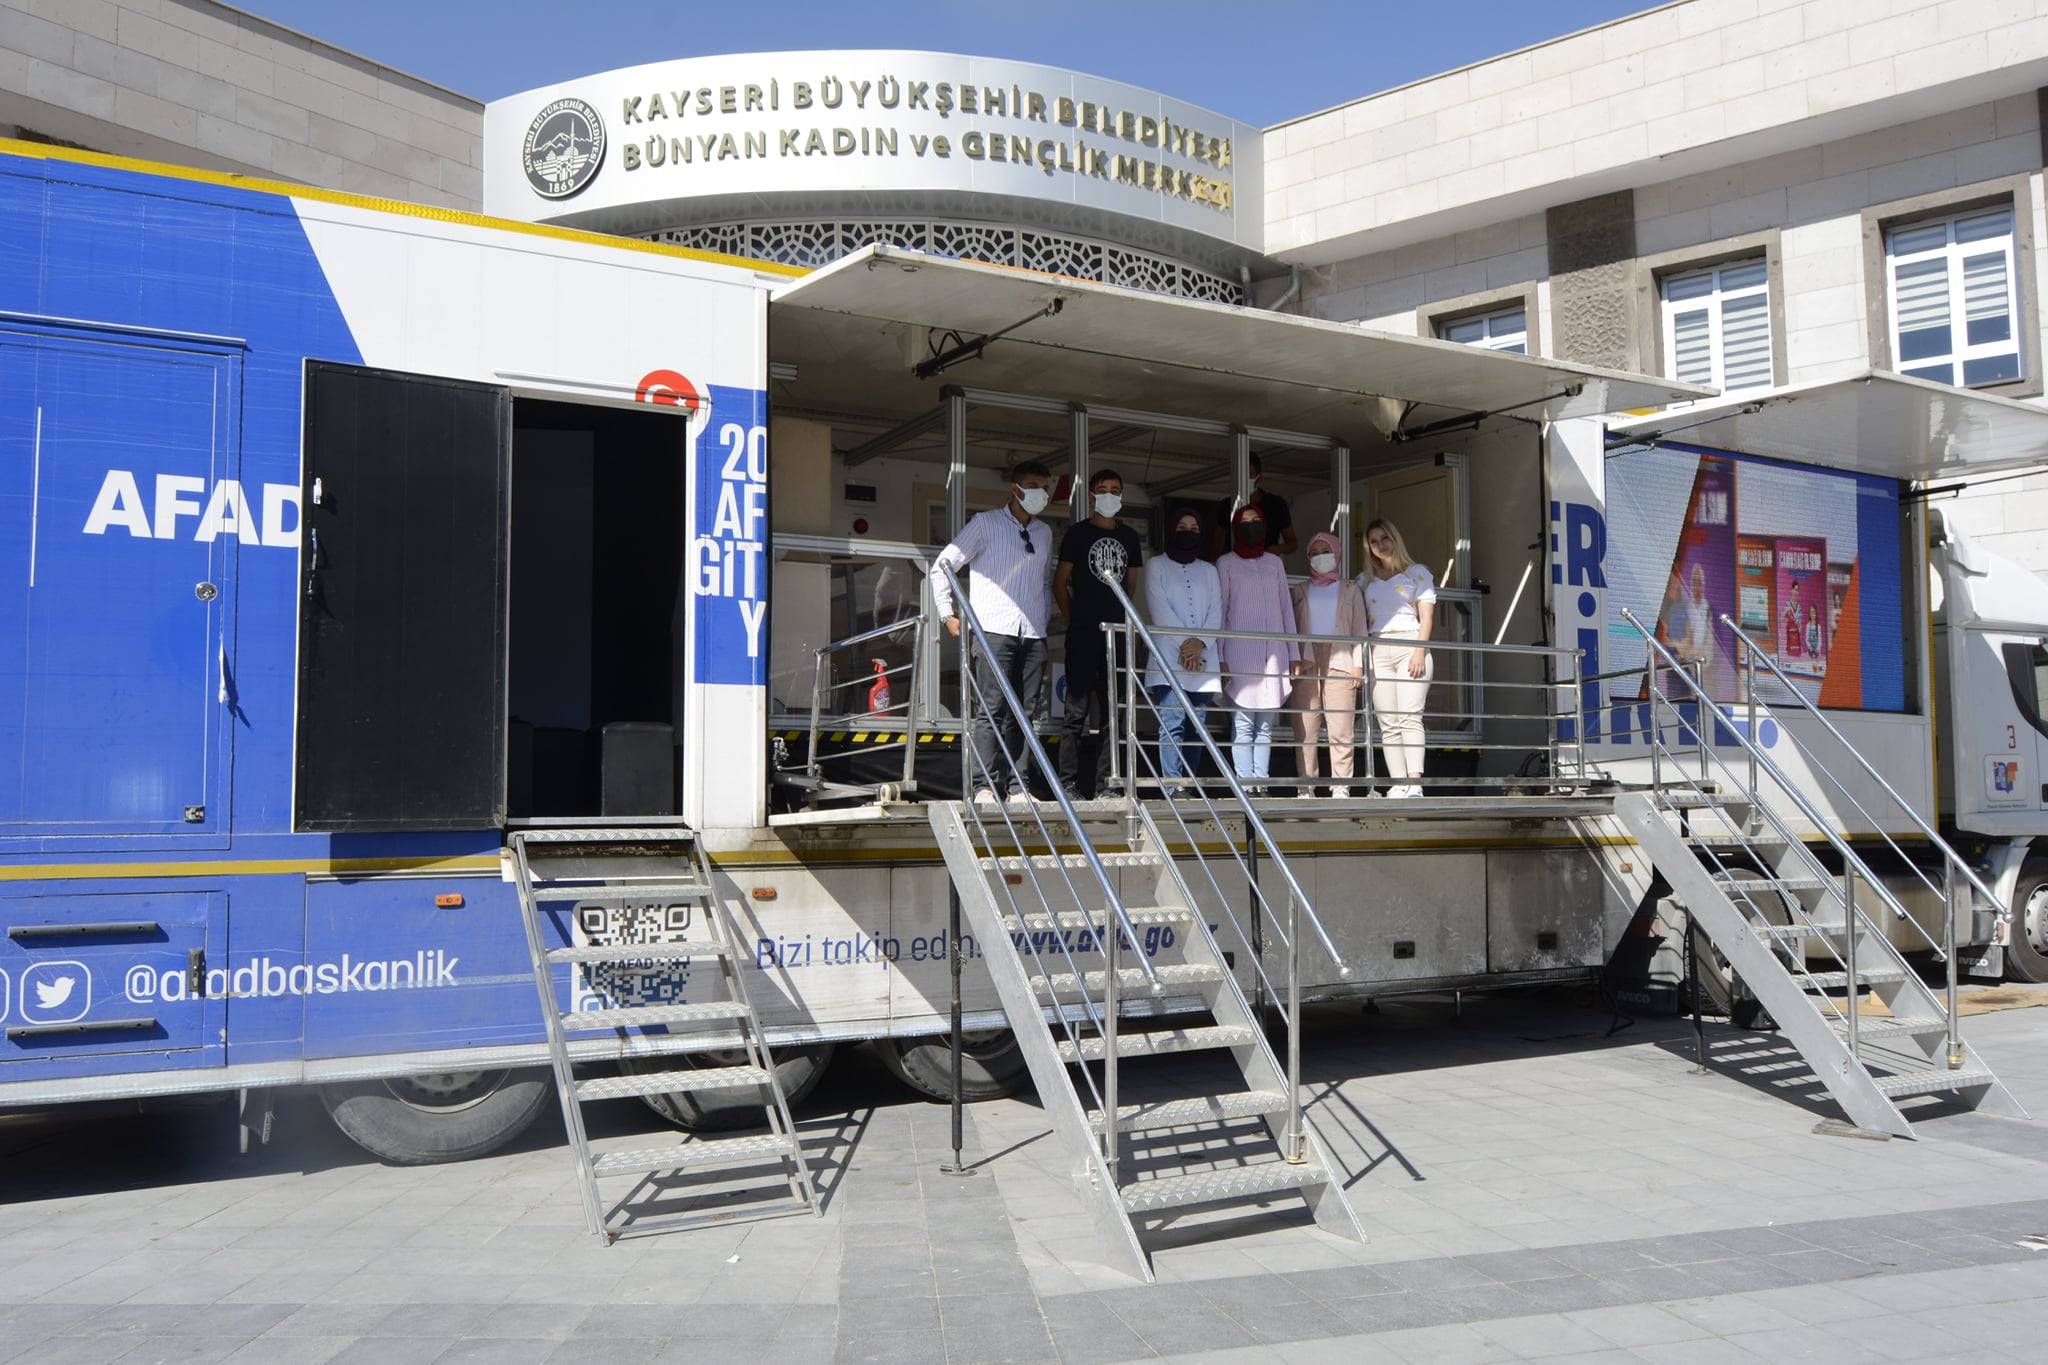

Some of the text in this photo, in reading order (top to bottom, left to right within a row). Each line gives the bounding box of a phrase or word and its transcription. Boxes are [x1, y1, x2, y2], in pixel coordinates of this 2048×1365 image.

[622, 74, 1231, 169] KAYSERİ BÜYÜKŞEHİR BELEDİYESİ
[548, 178, 575, 193] 1869
[622, 127, 1232, 209] BÜNYAN KADIN ve GENÇLİK MERKEZİ
[82, 469, 301, 548] AFAD
[617, 957, 654, 970] AFAD
[756, 934, 812, 970] Bizi
[821, 930, 900, 970] takip
